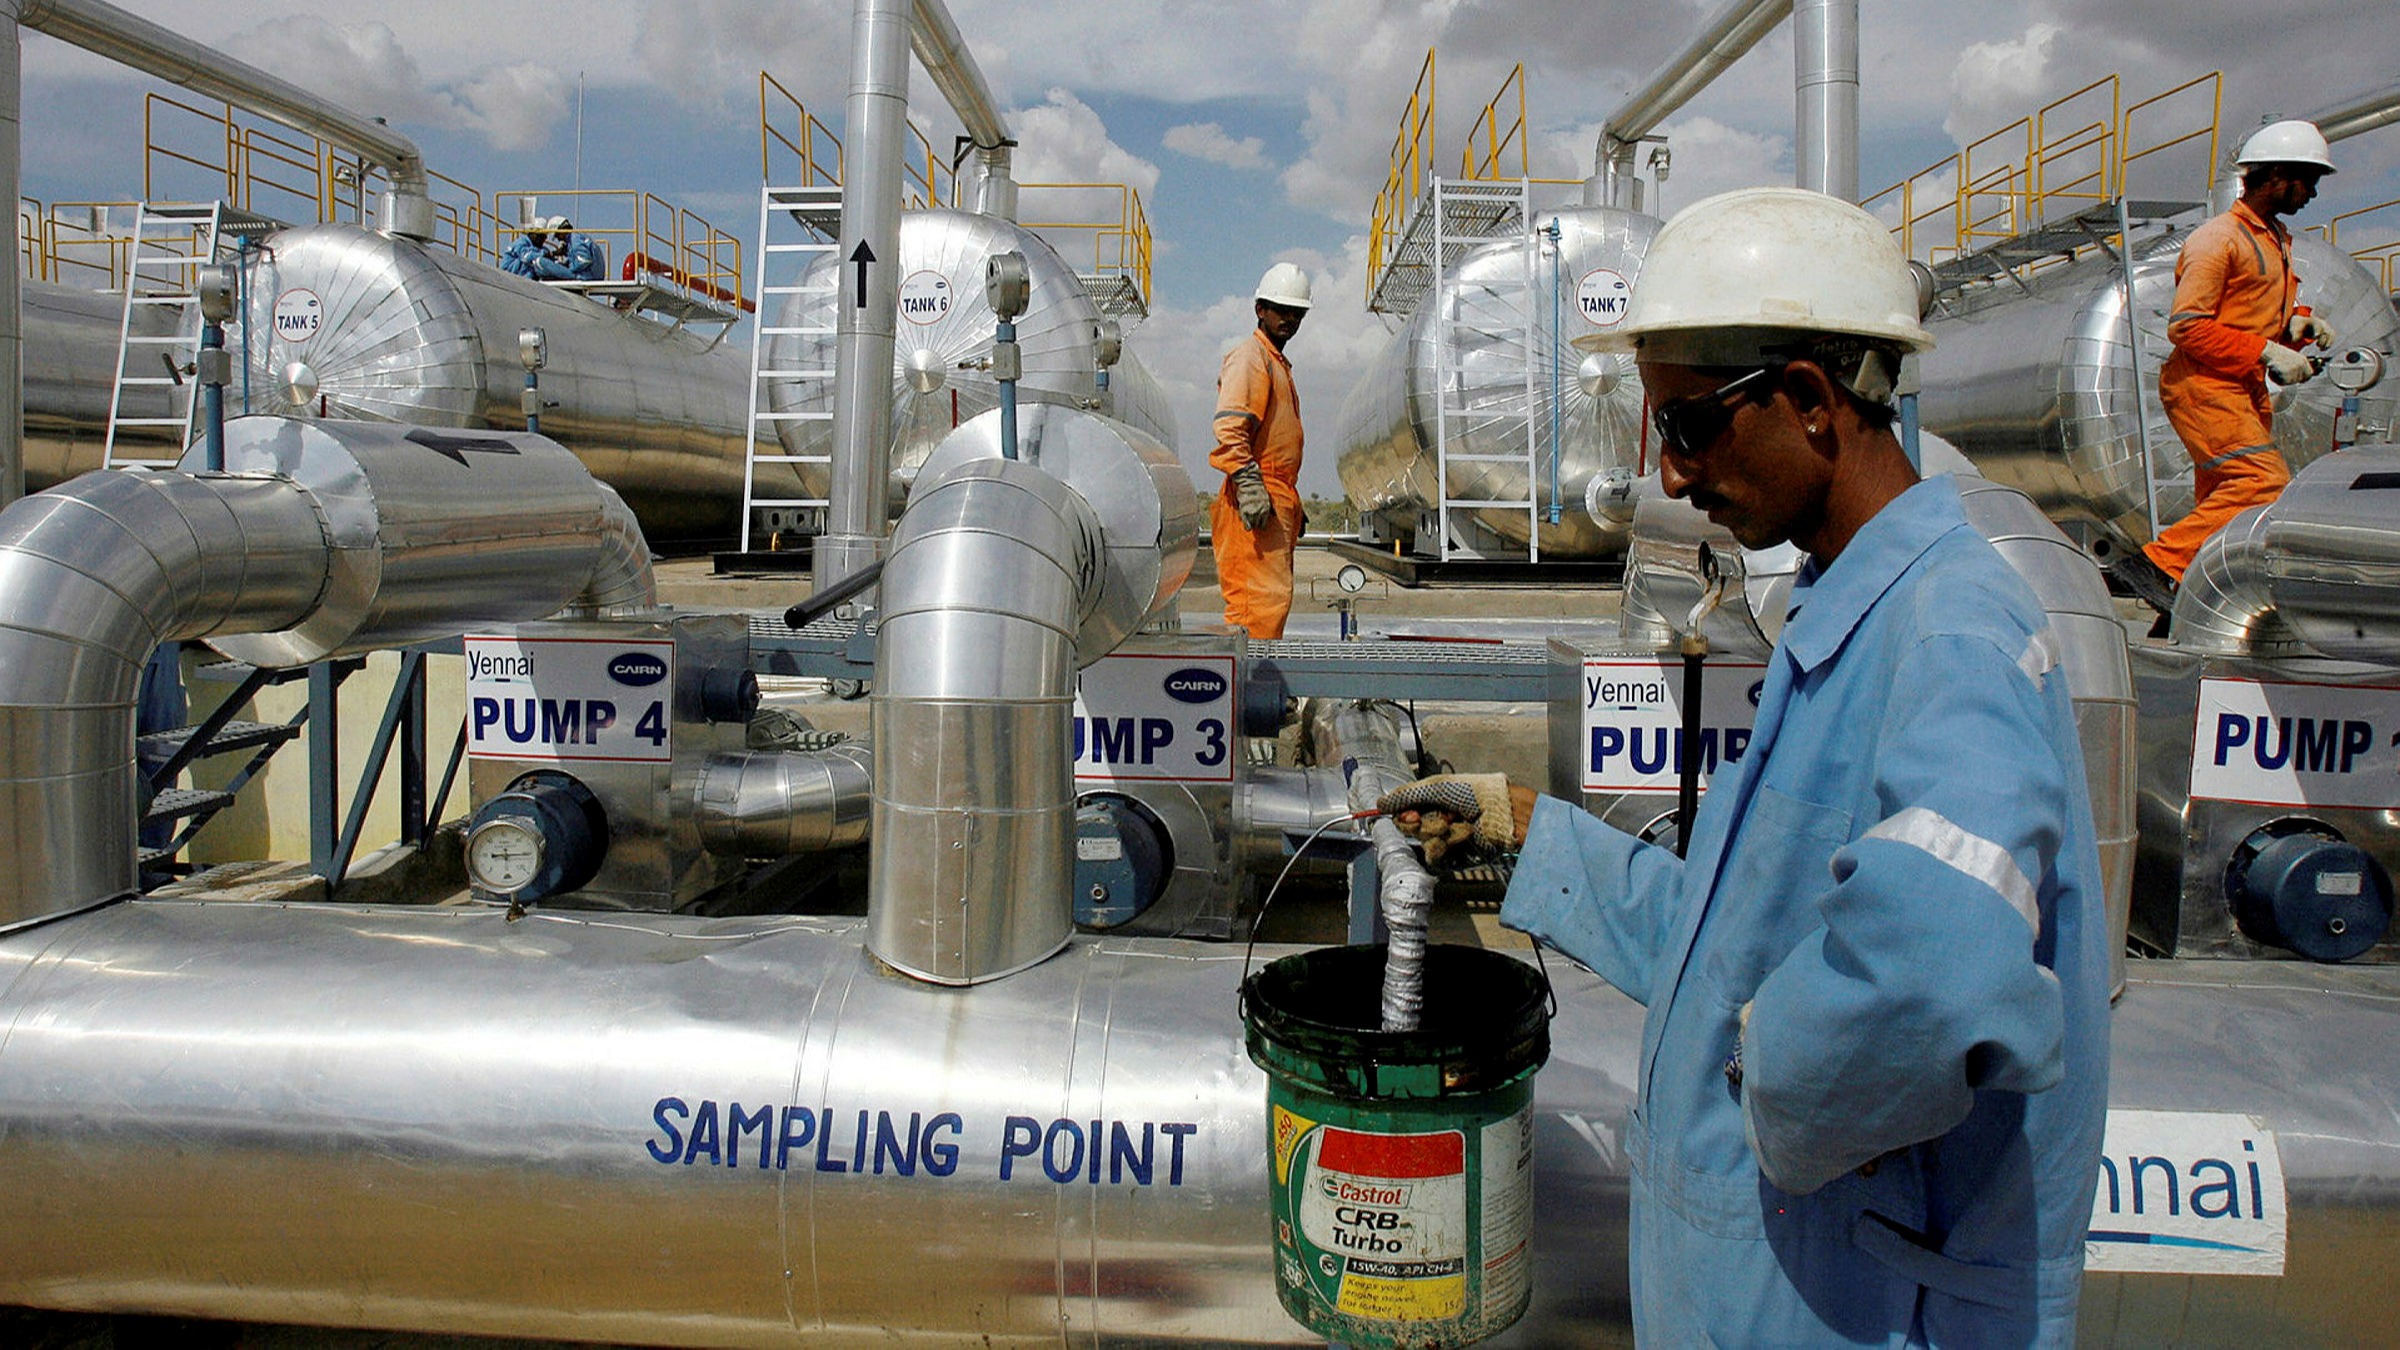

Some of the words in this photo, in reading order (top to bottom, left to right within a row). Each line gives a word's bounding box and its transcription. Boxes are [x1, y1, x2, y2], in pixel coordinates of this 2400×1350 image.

[903, 297, 936, 313] TANK
[940, 296, 947, 311] 6
[1582, 297, 1616, 312] TANK
[1619, 297, 1627, 312] 7
[278, 314, 308, 330] TANK
[311, 314, 318, 329] 5
[614, 664, 661, 675] CAIRN
[1170, 681, 1221, 691] CAIRN
[473, 697, 616, 744] PUMP
[635, 701, 667, 746] 4
[1195, 718, 1226, 766] 3
[2213, 713, 2372, 773] PUMP
[645, 1097, 963, 1178] SAMPLING
[999, 1115, 1197, 1186] POINT
[1339, 1182, 1403, 1205] Castrol
[1335, 1206, 1400, 1230] CRB
[1332, 1226, 1403, 1253] Turbo
